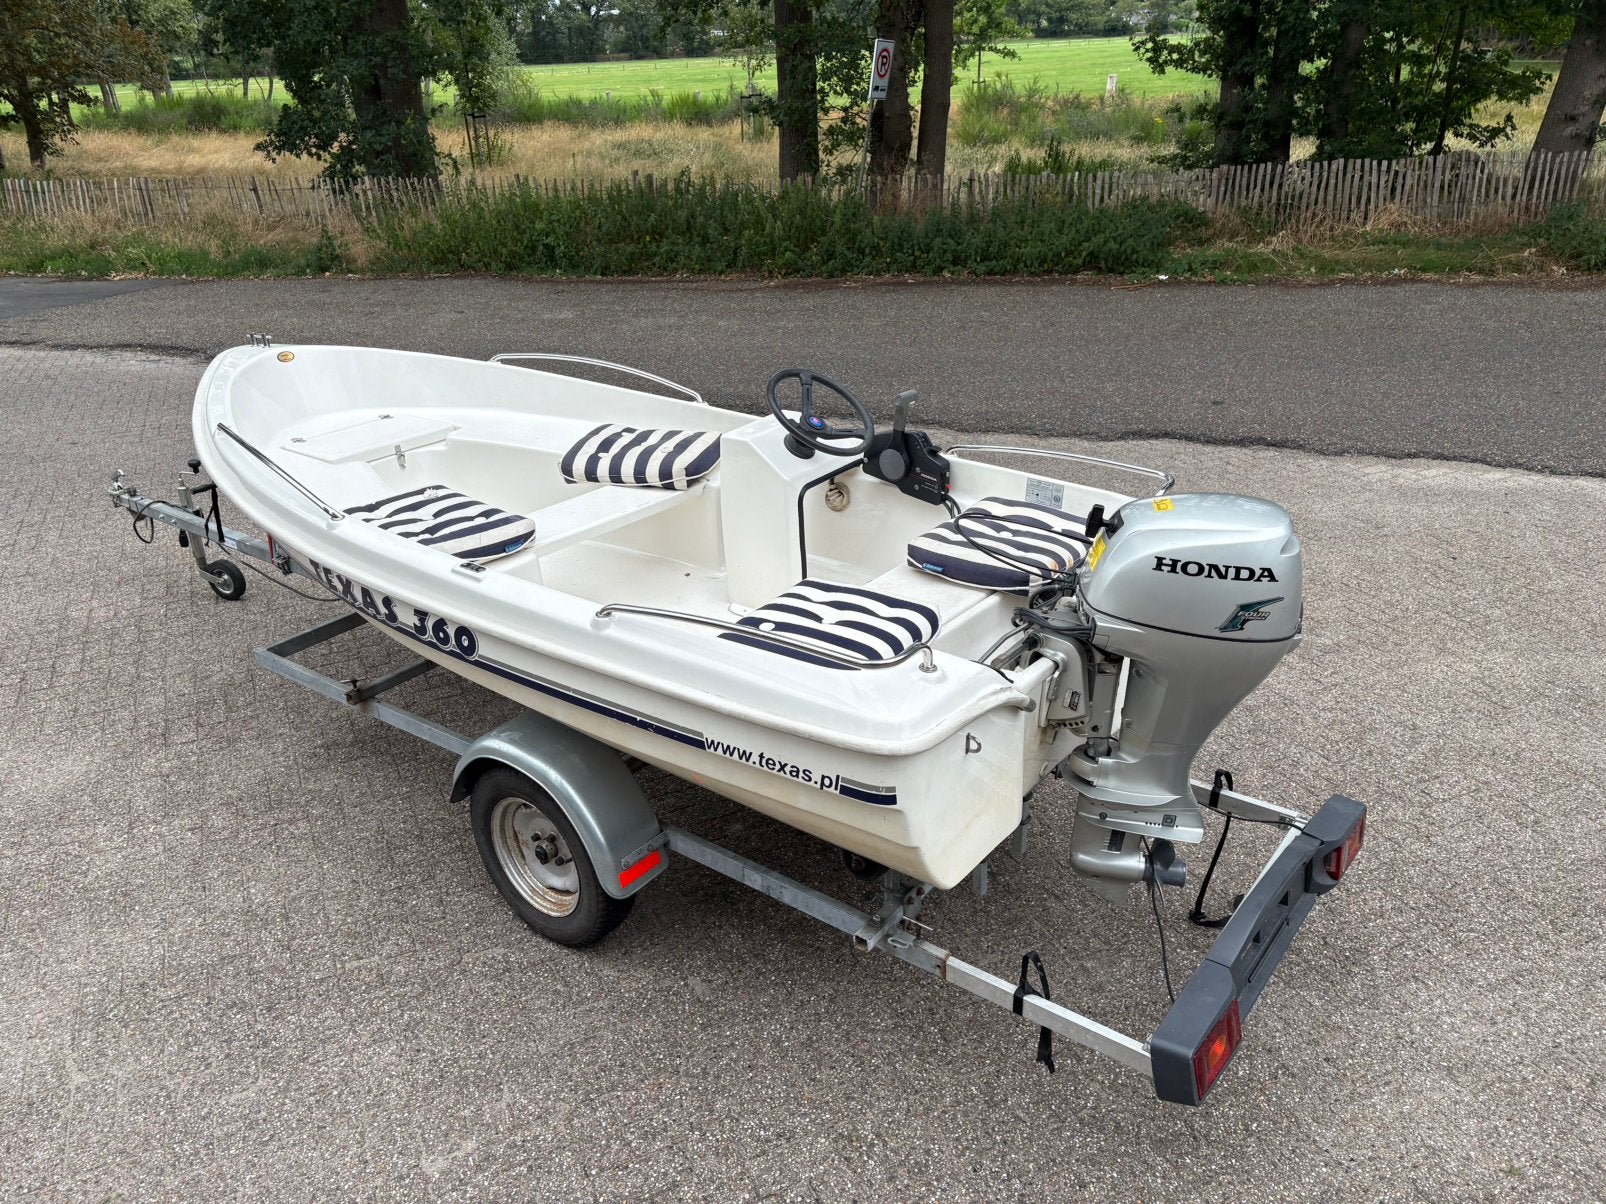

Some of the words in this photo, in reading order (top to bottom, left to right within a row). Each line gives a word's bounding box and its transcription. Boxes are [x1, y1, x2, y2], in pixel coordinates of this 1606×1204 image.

[1152, 556, 1279, 582] HONDA
[308, 557, 399, 626] TEXAS
[412, 608, 479, 660] 360
[705, 737, 840, 791] www.texas.pl
